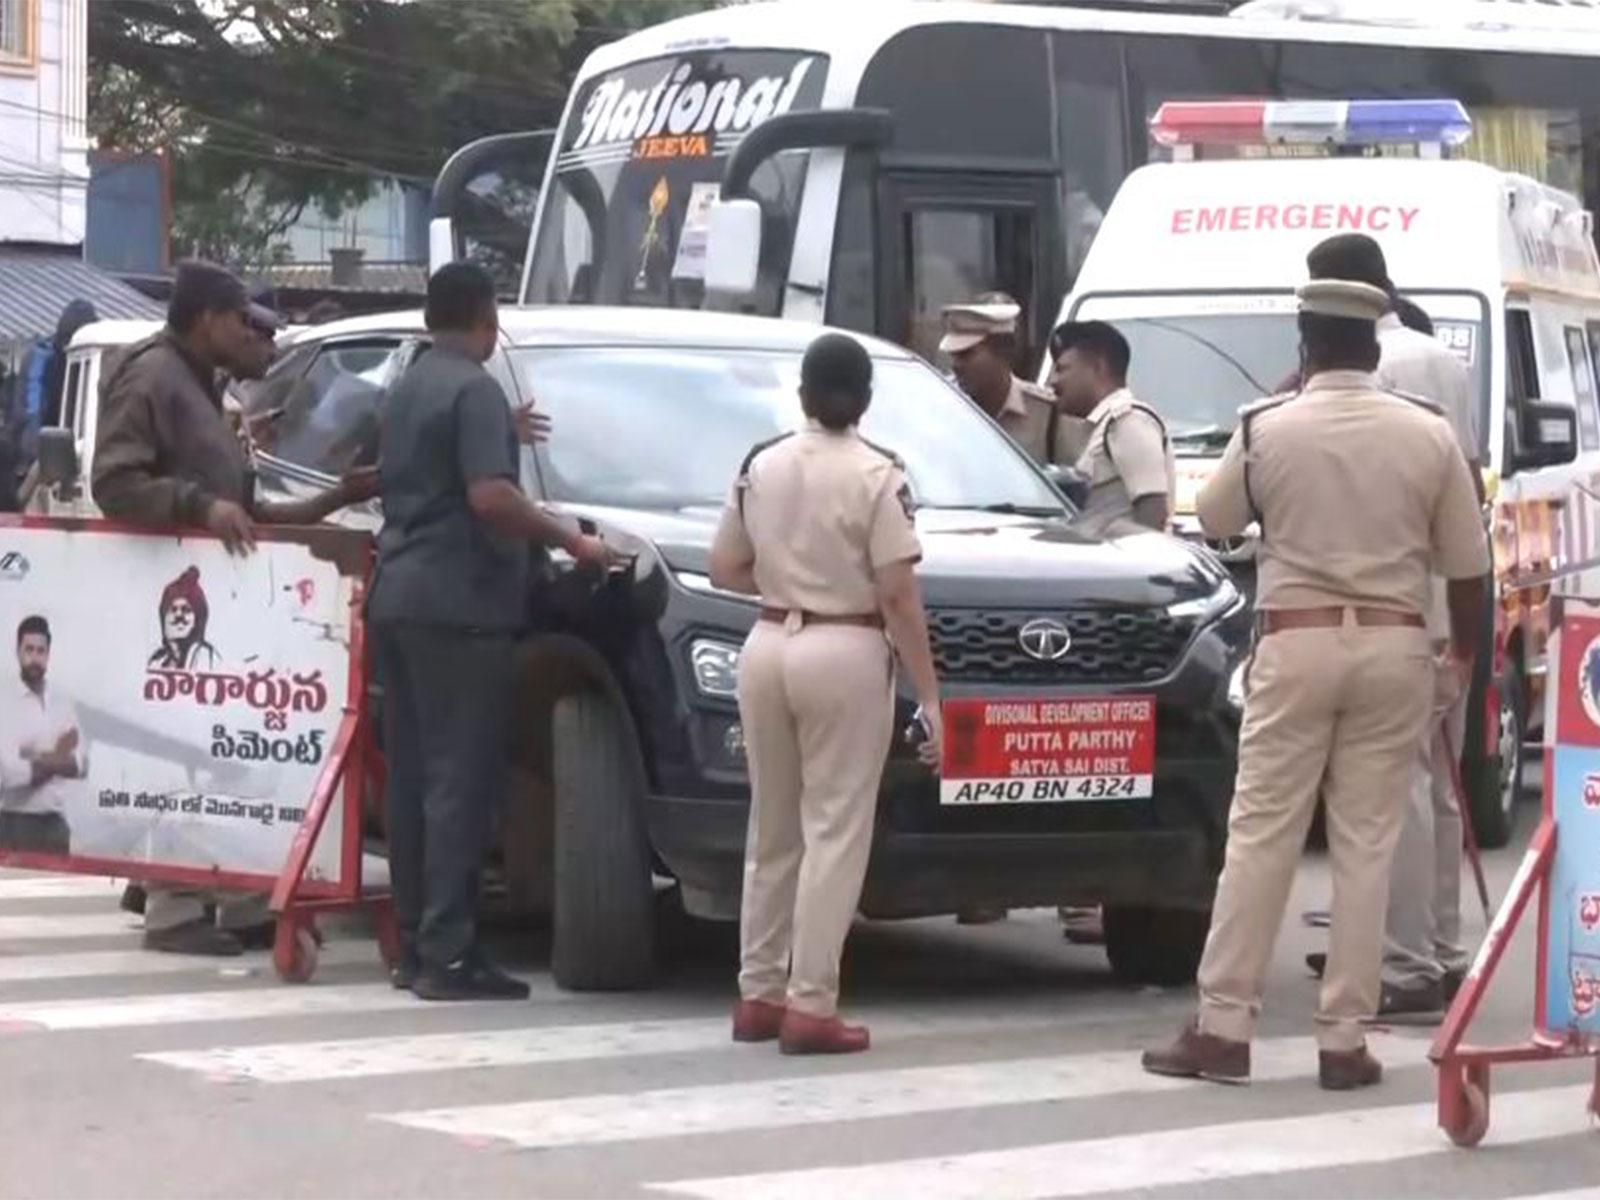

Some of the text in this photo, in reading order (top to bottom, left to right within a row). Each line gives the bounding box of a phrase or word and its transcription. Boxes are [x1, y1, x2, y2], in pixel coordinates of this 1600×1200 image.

[574, 57, 812, 149] National
[634, 135, 708, 158] JEEVA
[1171, 203, 1420, 235] EMERGENCY
[144, 667, 327, 730] నాగార్జున
[1040, 701, 1109, 724] DEVELOPMENT
[1111, 700, 1150, 721] OFFICER
[211, 723, 326, 765] సిమెంట్
[1004, 730, 1136, 752] PUTTA PARTHY
[1010, 758, 1059, 775] SATYA
[1064, 758, 1089, 774] SAI
[954, 777, 1135, 801] AP40 BN 4324
